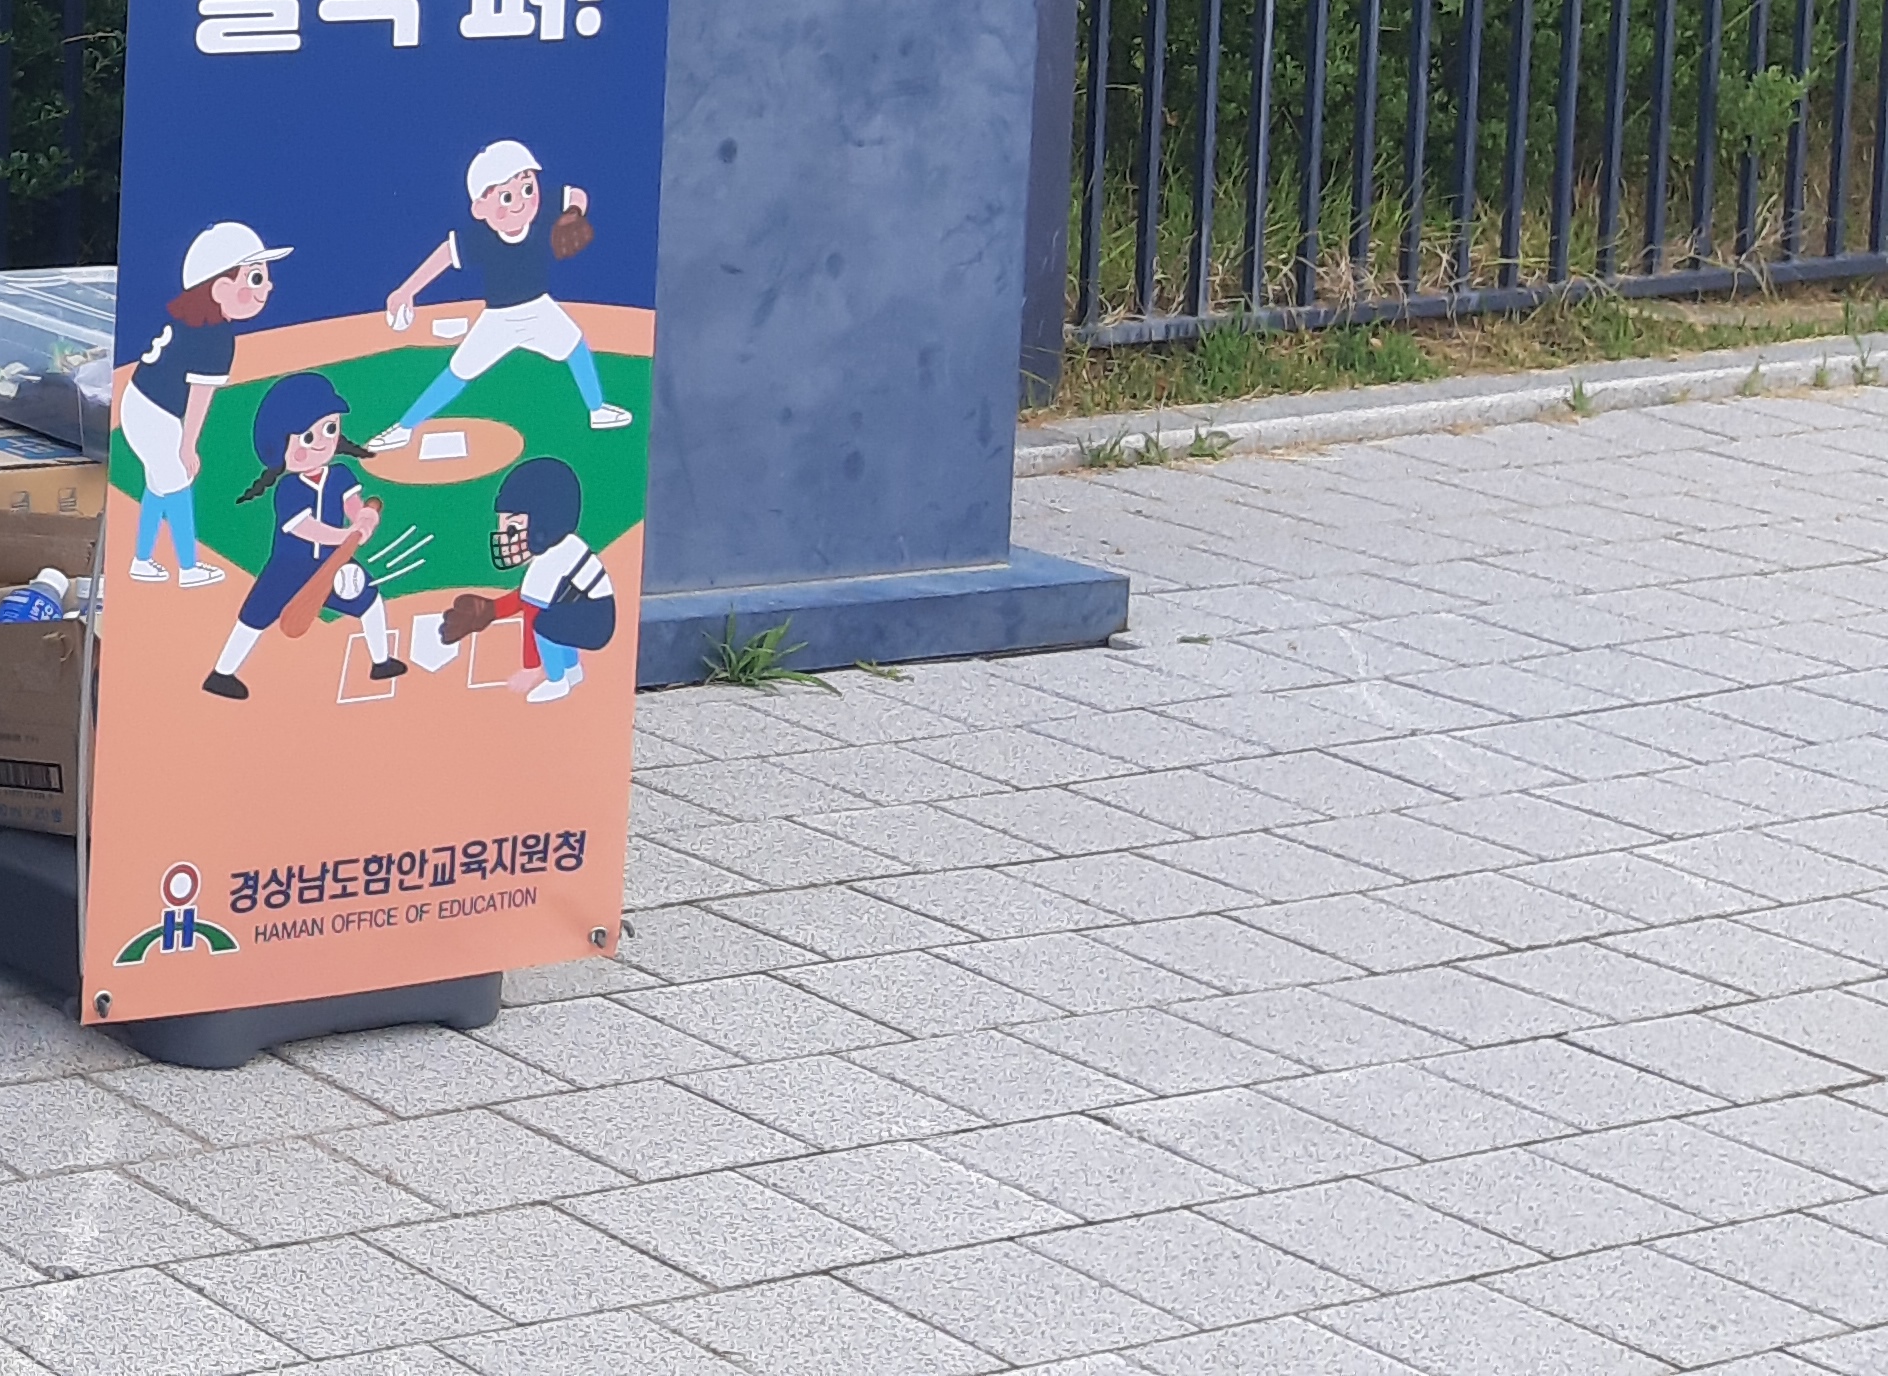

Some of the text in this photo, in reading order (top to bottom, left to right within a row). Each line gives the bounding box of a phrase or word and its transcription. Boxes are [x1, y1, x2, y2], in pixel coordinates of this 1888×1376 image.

[227, 828, 589, 915] 경상남도함안교육지원청
[253, 886, 539, 944] HAMAN OFFICE OF EDUCATION
